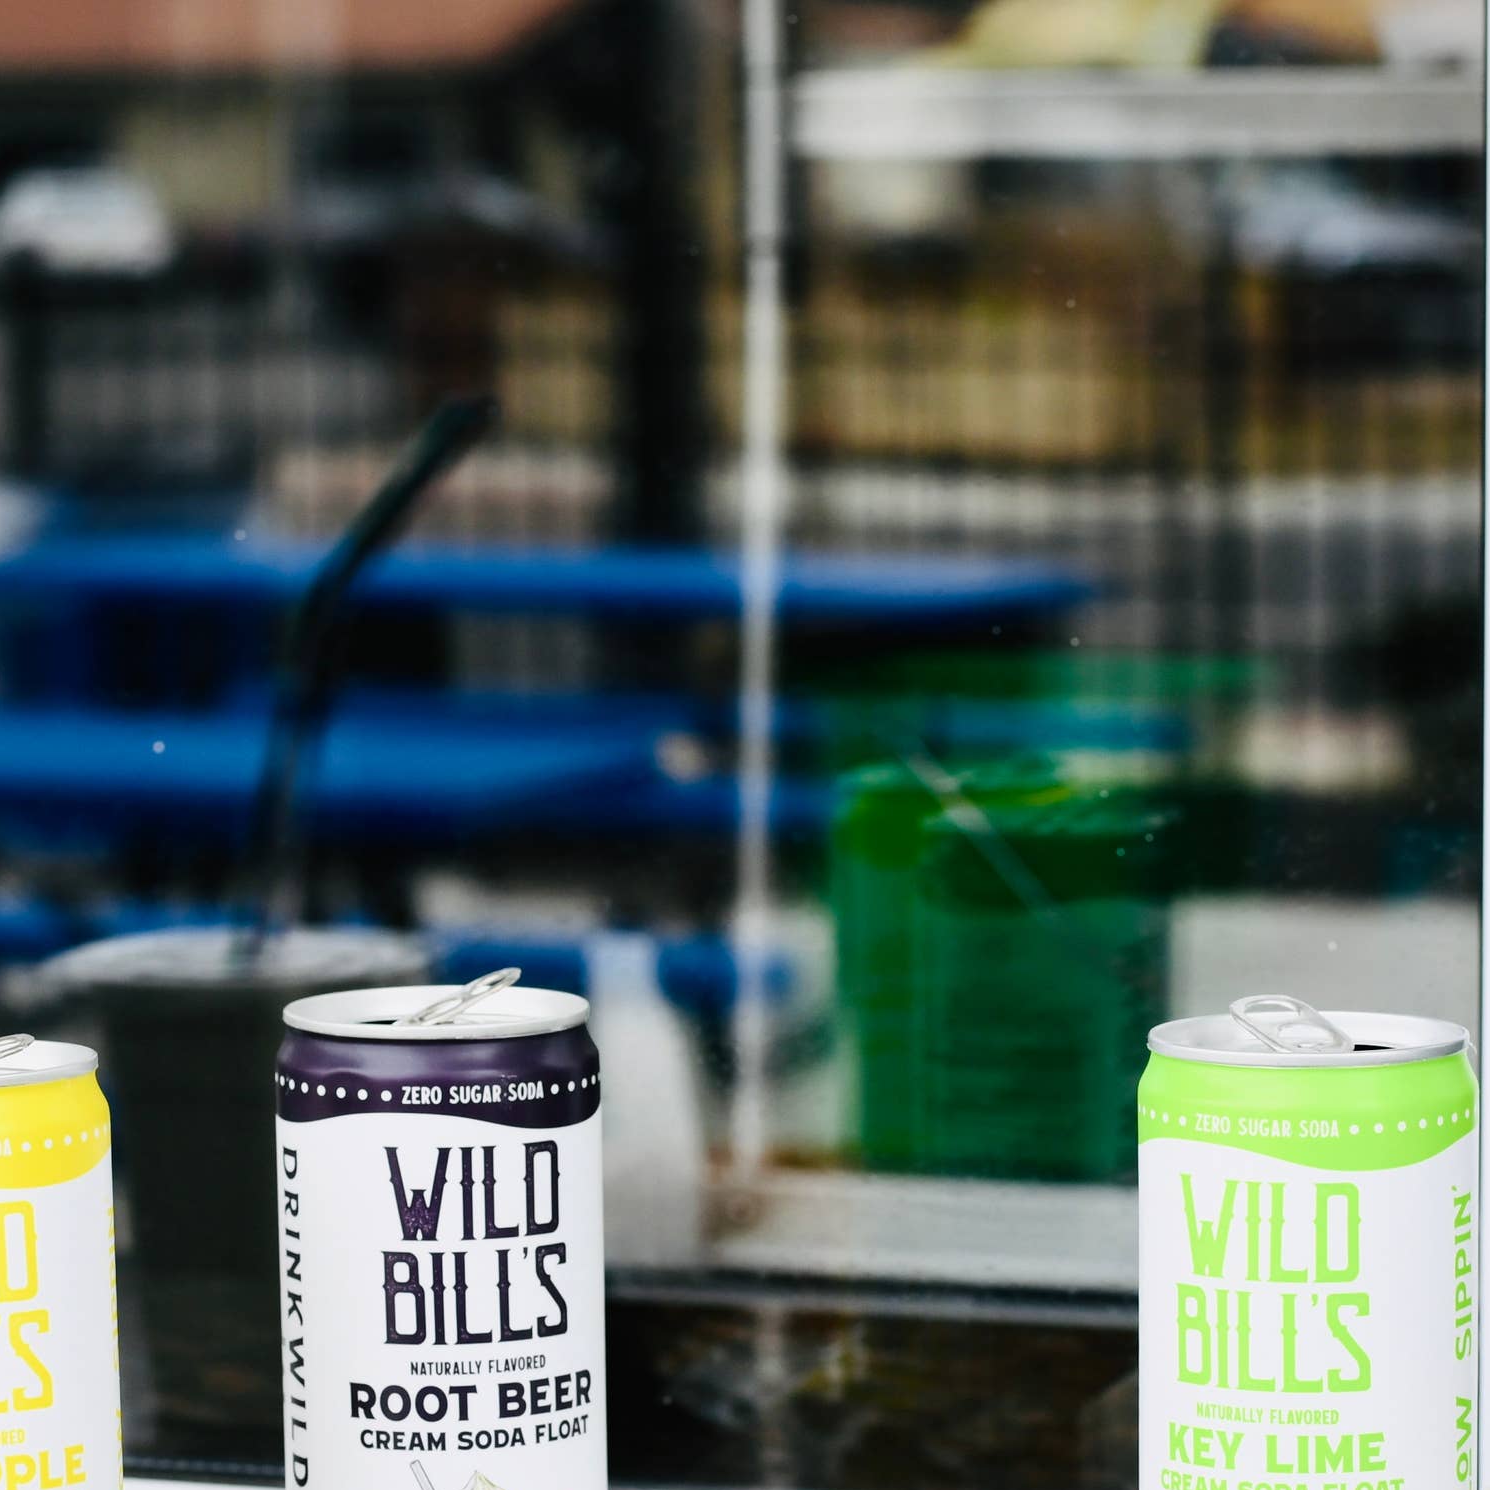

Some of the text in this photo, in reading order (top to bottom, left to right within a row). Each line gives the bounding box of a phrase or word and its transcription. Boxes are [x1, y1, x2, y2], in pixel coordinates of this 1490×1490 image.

[402, 1081, 544, 1105] ZERO SUGAR SODA
[1195, 1113, 1340, 1138] ZERO SUGAR SODA
[383, 1140, 560, 1241] WILD
[1180, 1173, 1361, 1283] WILD
[381, 1242, 568, 1345] BILL'S
[1176, 1283, 1372, 1393] BILL'S
[411, 1355, 546, 1376] NATURALLY FLAVORED
[349, 1369, 591, 1422] ROOT BEER
[1196, 1402, 1340, 1425] NATURALLY FLAVORED
[360, 1414, 589, 1451] CREAM SODA FLOAT
[1168, 1422, 1387, 1474] KEY LIME
